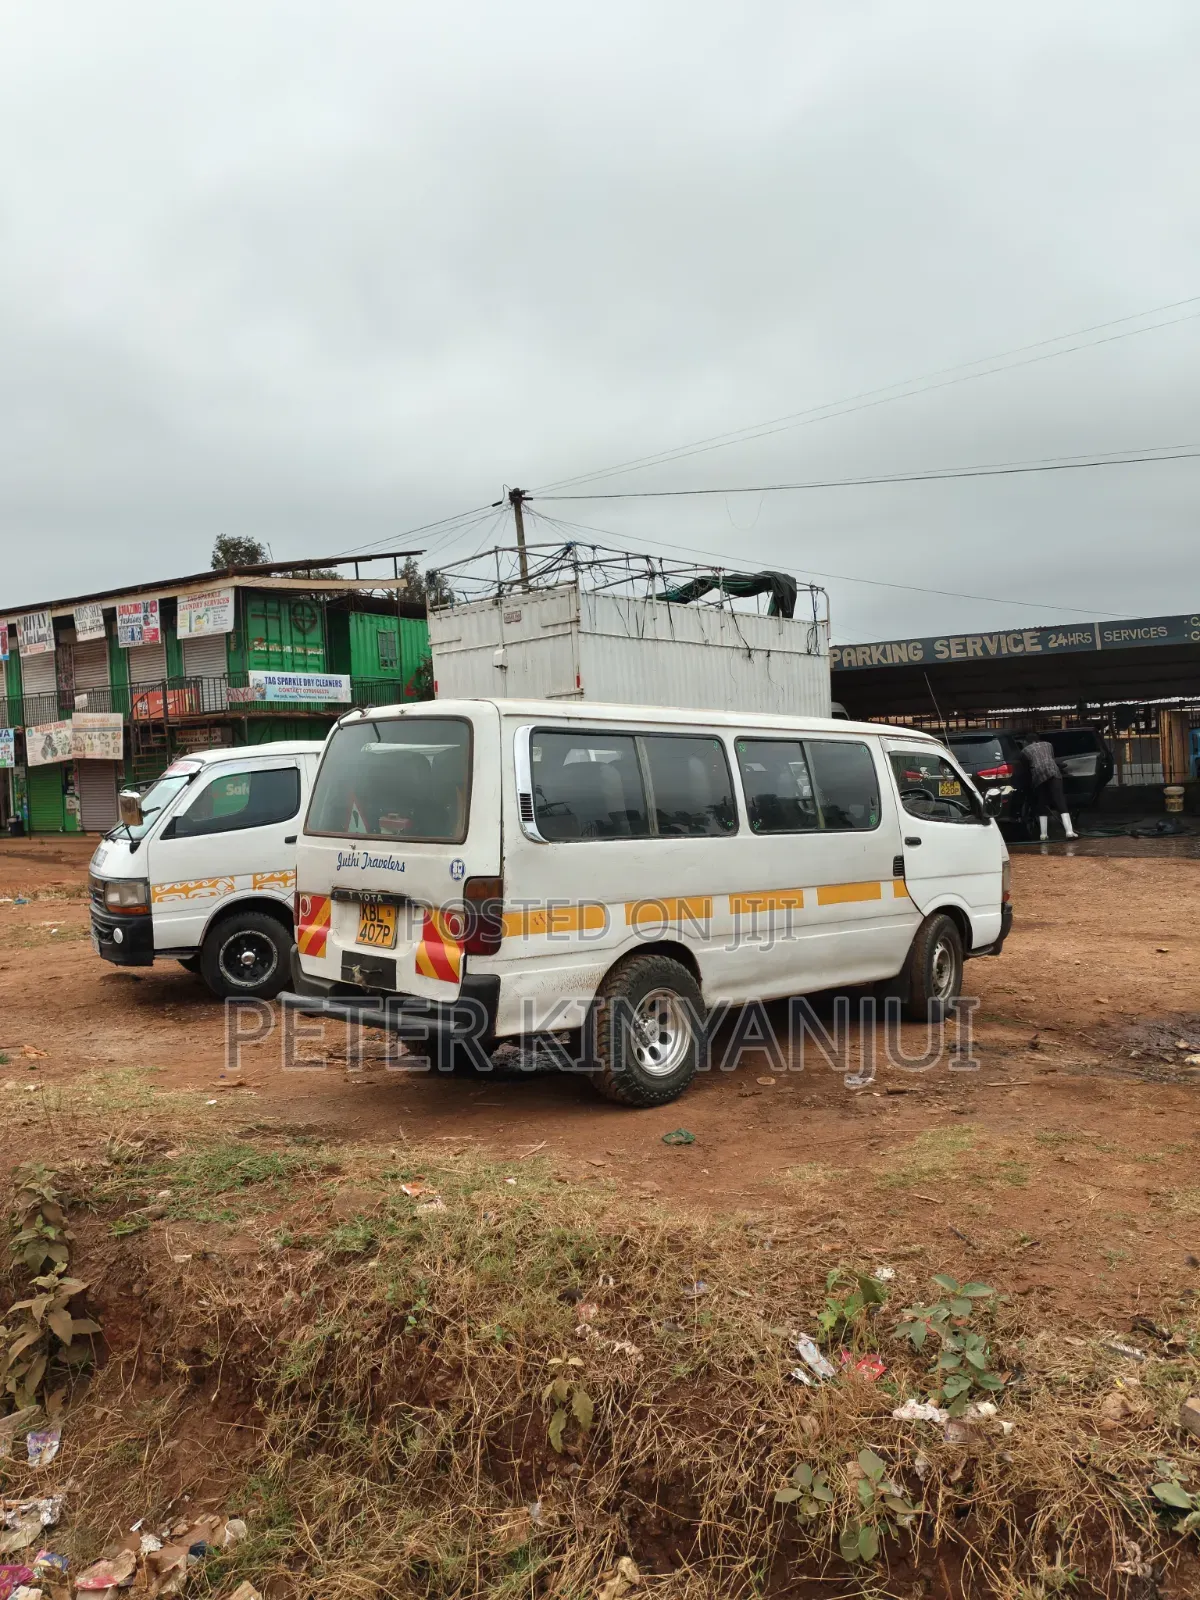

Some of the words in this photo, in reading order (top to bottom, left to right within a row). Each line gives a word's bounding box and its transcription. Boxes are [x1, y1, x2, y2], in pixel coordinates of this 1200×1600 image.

[203, 597, 230, 607] SERVICES
[830, 641, 924, 668] PARKING
[933, 631, 1043, 660] SERVICE
[1047, 632, 1093, 648] 24HRS
[1103, 626, 1168, 642] SERVICES
[264, 676, 277, 685] TAG
[277, 677, 302, 687] SPARKLE
[303, 678, 315, 687] DRY
[315, 679, 342, 688] CLEANERS
[361, 852, 405, 872] Travelers
[361, 903, 384, 923] KBL
[359, 923, 391, 943] 407P
